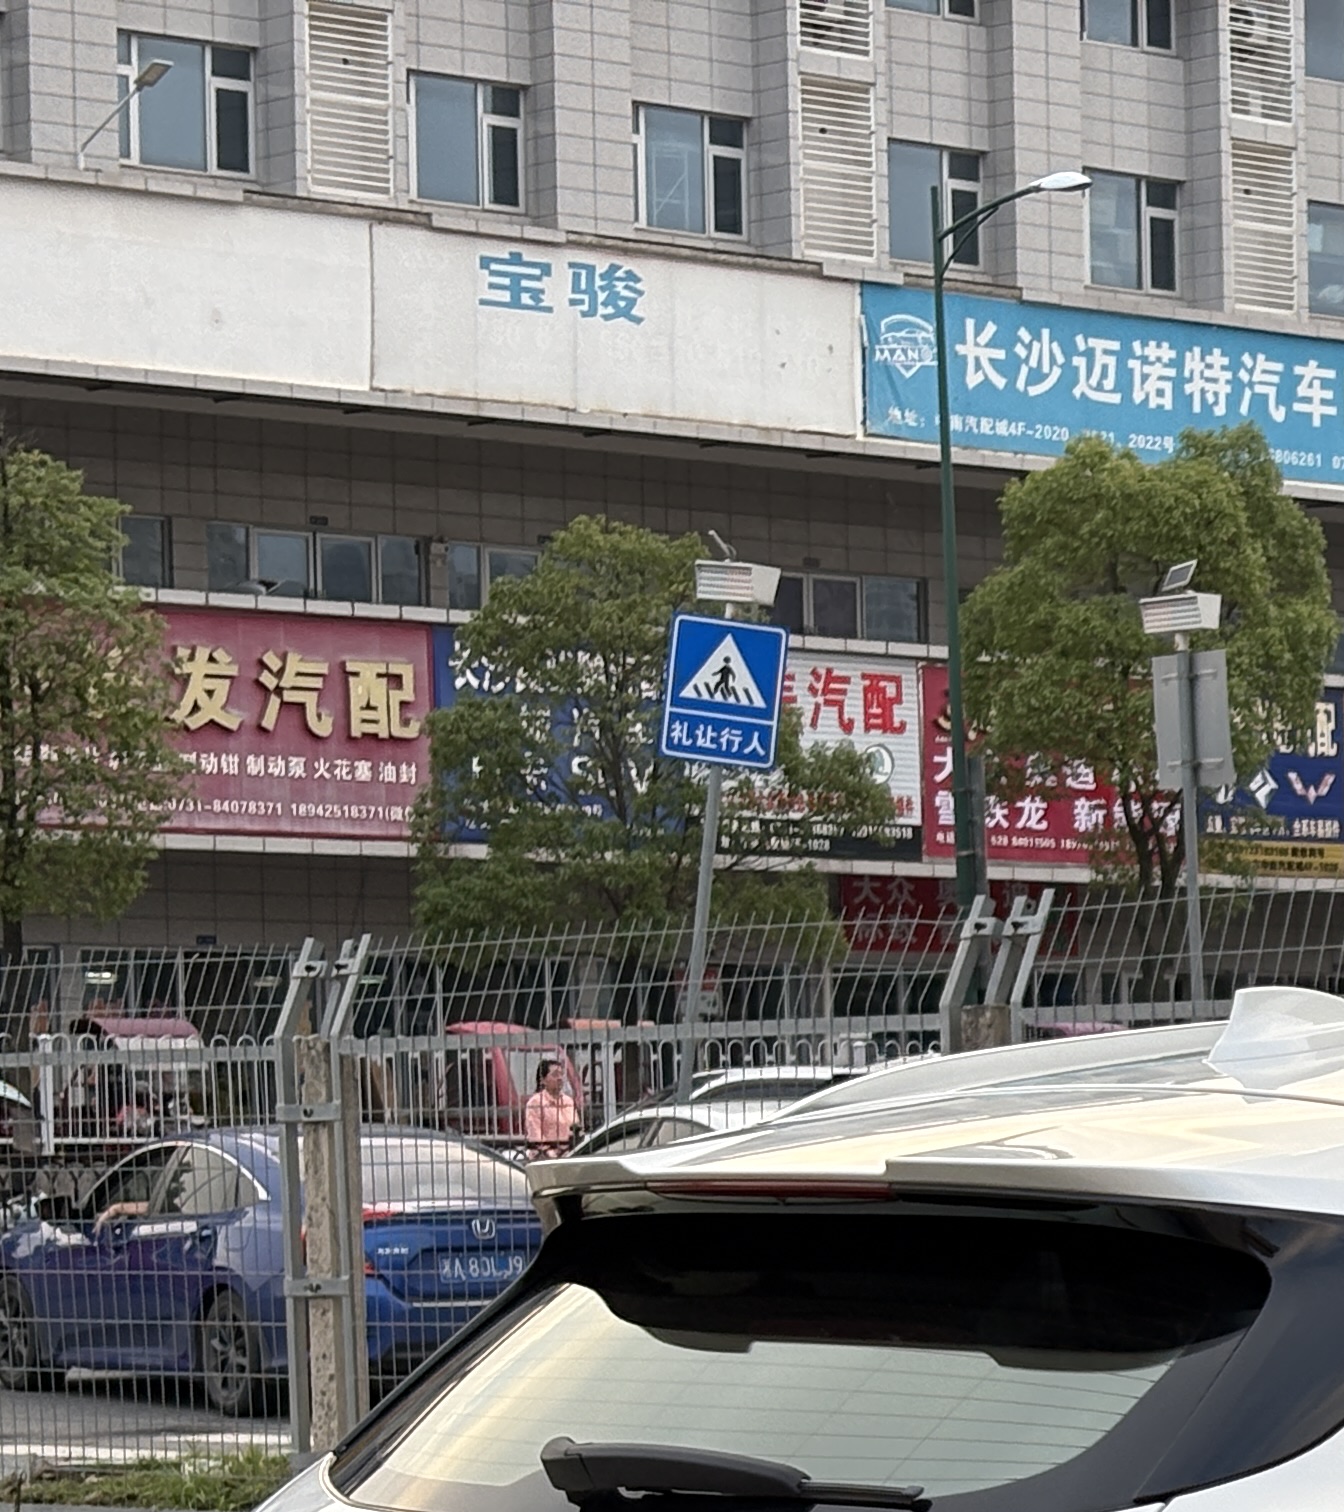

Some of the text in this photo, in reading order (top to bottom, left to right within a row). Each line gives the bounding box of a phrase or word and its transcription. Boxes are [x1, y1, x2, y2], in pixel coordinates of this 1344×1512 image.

[478, 251, 646, 325] 宝骏
[100, 643, 421, 740] 发汽配
[671, 720, 766, 757] 礼让行人
[313, 757, 373, 782] 火花塞
[379, 761, 417, 786] 油封
